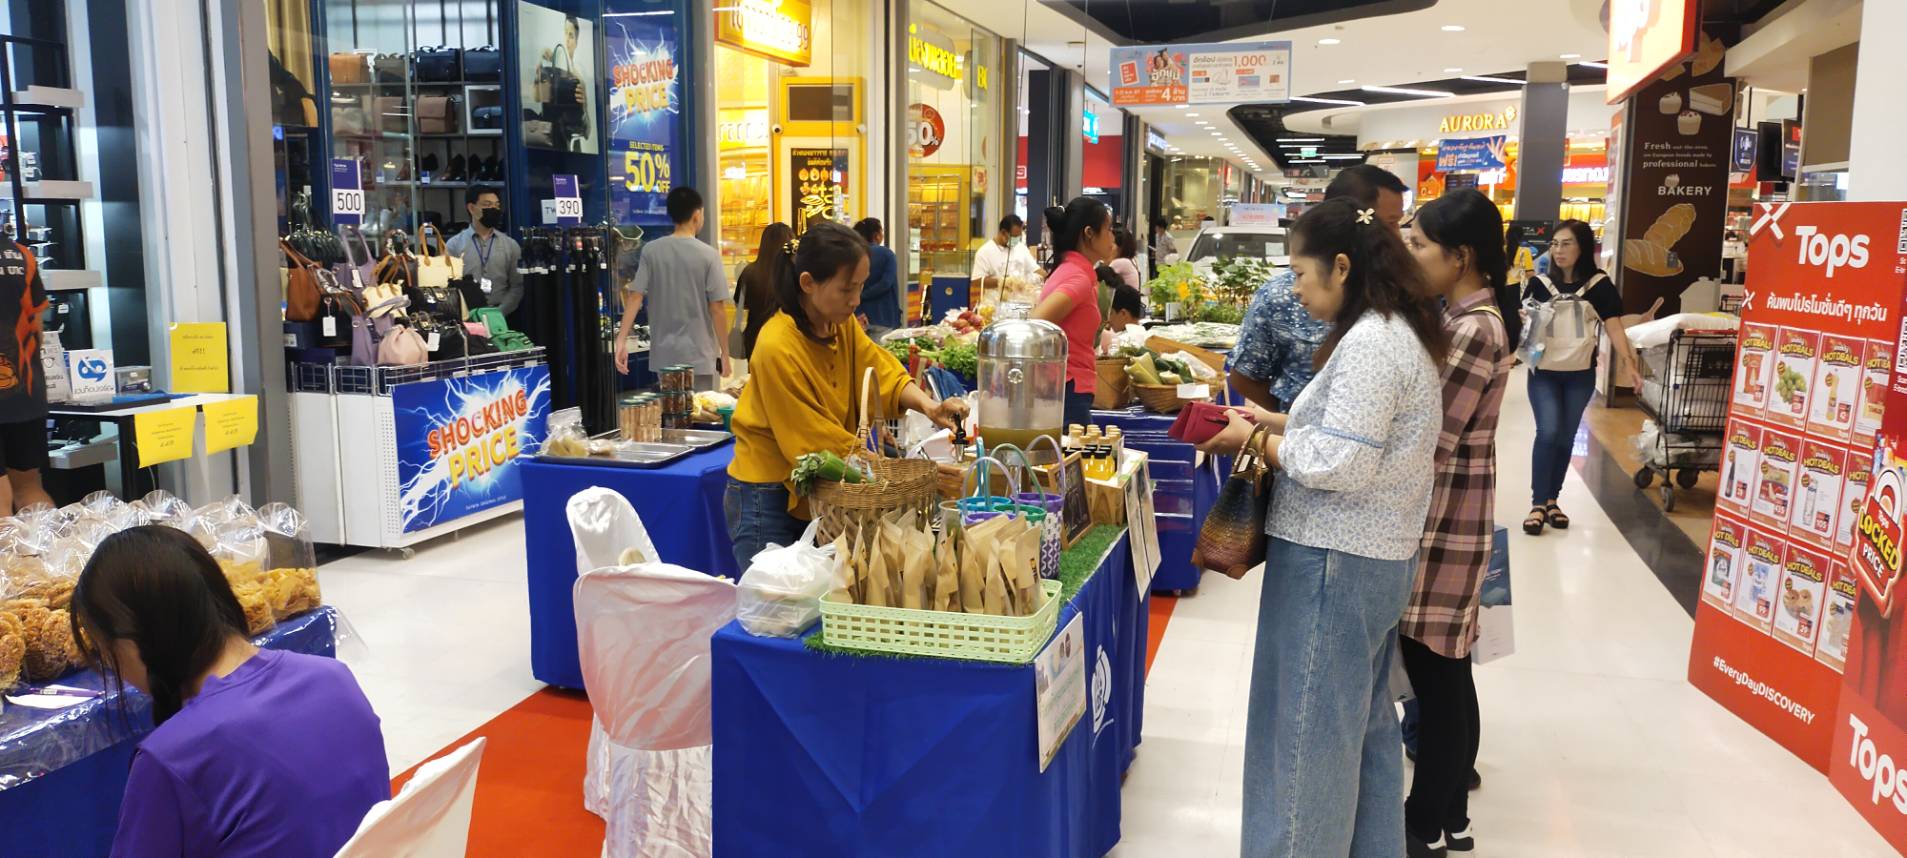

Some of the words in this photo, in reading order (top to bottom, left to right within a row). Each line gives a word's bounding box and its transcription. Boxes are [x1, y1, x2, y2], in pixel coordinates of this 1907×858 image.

[612, 59, 674, 87] SHOCKING
[1232, 55, 1267, 67] 1,000
[624, 83, 670, 113] PRICE
[1161, 87, 1172, 102] 4
[1439, 113, 1507, 133] AURORA
[1644, 142, 1671, 150] Fresh
[1642, 160, 1698, 168] professional
[656, 180, 671, 193] OFF
[1657, 186, 1713, 196] BAKERY
[337, 192, 361, 211] 500
[559, 200, 580, 215] 390
[1795, 225, 1871, 278] Tops
[1766, 291, 1853, 322] ค้นพบโปรโมชั่นดีๆ
[1853, 301, 1888, 325] ทุกวัน
[427, 389, 528, 459] SHOCKING
[449, 426, 521, 489] PRICE
[1859, 511, 1899, 571] LOCKED
[1862, 543, 1885, 578] PRICE
[1713, 655, 1816, 726] #EveryDayDISCOVERY
[1848, 712, 1907, 816] Tops
